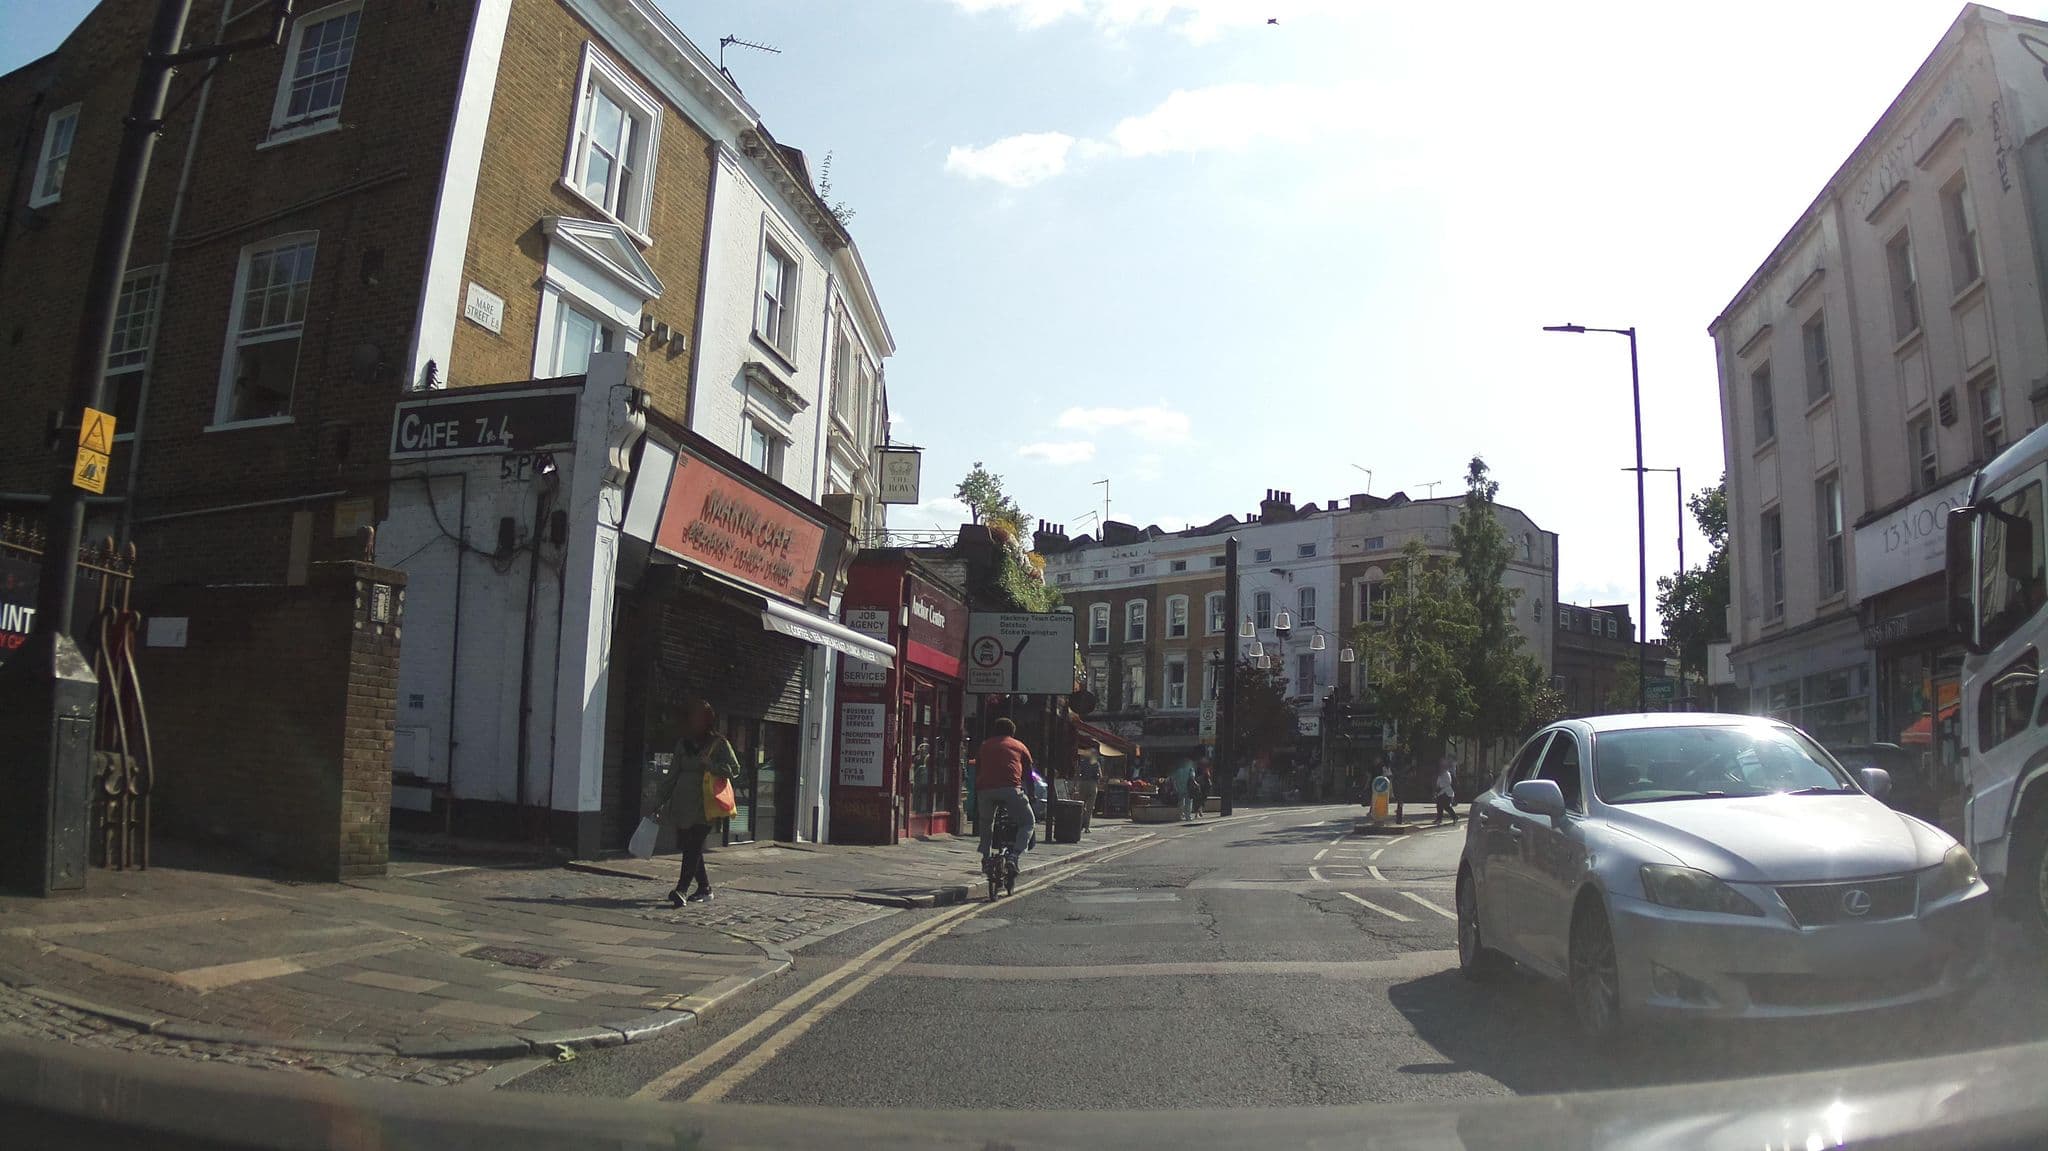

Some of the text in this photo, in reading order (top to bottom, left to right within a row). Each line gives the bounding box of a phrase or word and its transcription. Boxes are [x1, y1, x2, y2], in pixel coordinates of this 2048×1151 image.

[467, 305, 490, 323] STREET
[401, 413, 460, 449] CAFE
[1883, 524, 1901, 554] 13
[0, 603, 36, 634] INT
[858, 611, 876, 620] JOB
[850, 620, 885, 630] AGENCY
[861, 662, 869, 670] IT
[844, 672, 886, 681] SERVICES
